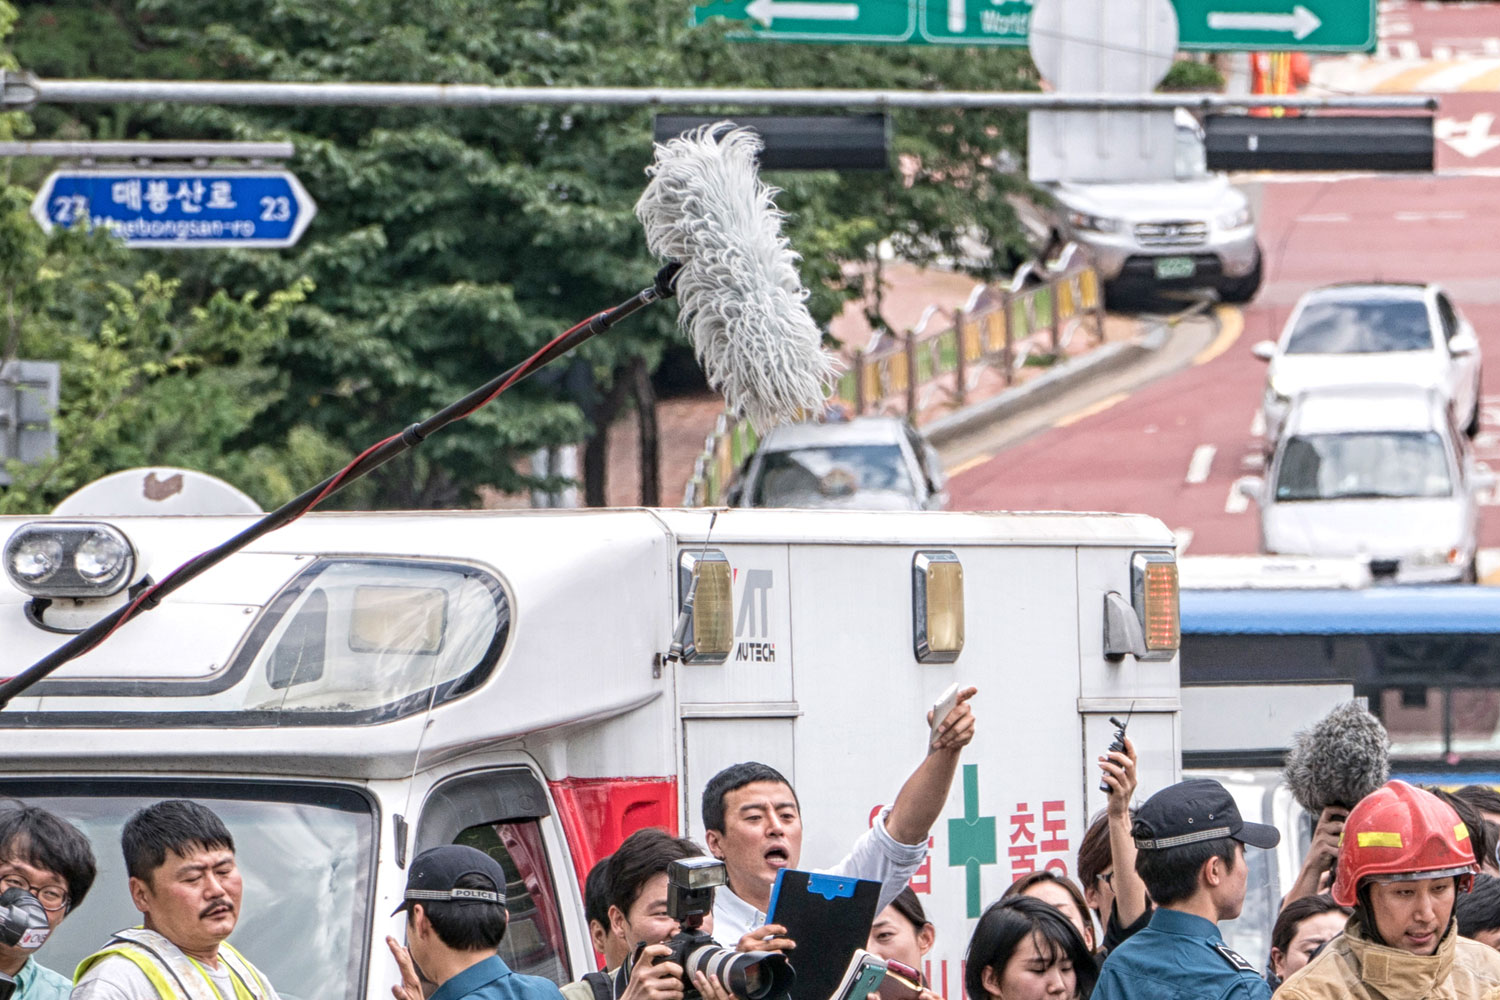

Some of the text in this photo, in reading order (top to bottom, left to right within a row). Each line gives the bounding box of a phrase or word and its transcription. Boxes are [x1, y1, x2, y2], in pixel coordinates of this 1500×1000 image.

[111, 179, 237, 213] 매봉산로
[259, 197, 291, 221] 23
[735, 643, 776, 662] AUTECH
[455, 889, 494, 900] POLICE
